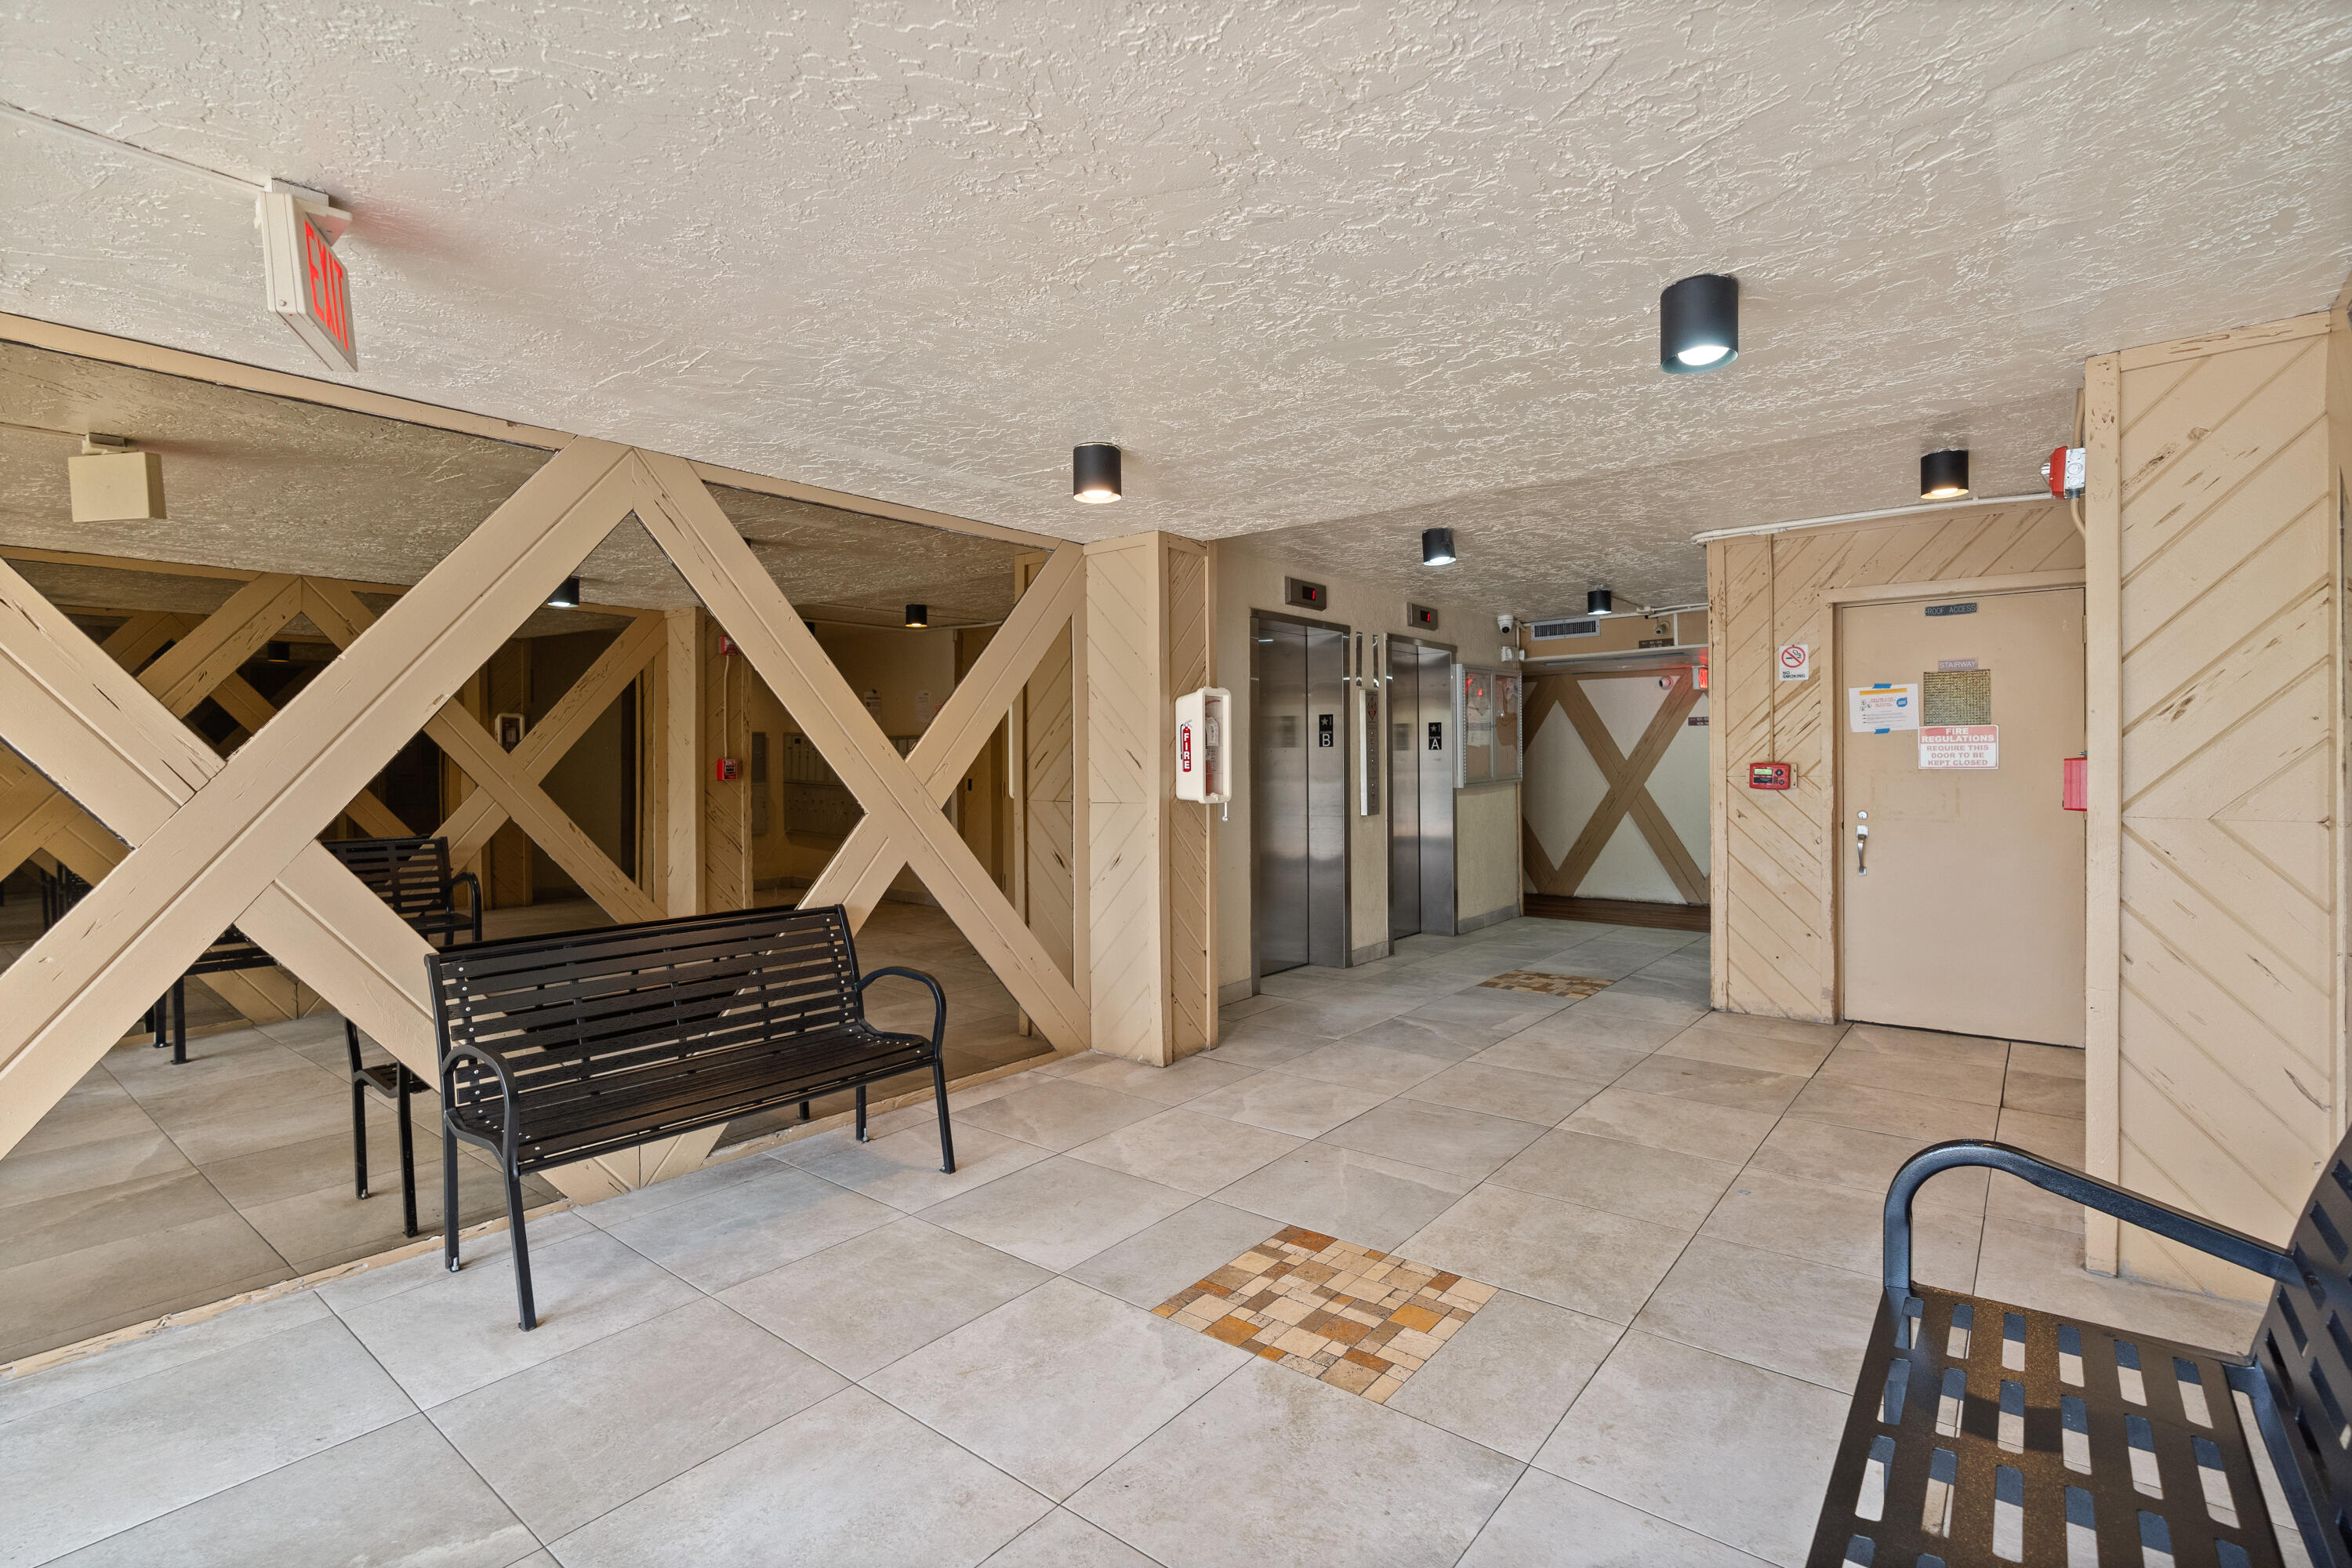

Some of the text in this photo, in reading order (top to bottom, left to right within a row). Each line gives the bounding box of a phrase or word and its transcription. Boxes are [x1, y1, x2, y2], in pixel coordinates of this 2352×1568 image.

[304, 219, 349, 351] EXIT
[1312, 589, 1316, 601] 1
[1927, 604, 1976, 615] ROOF ACCESS
[1939, 660, 1976, 669] STAIRWAY
[1323, 733, 1330, 747] B
[1431, 739, 1439, 750] A
[1921, 735, 1994, 743] REGULATIONS
